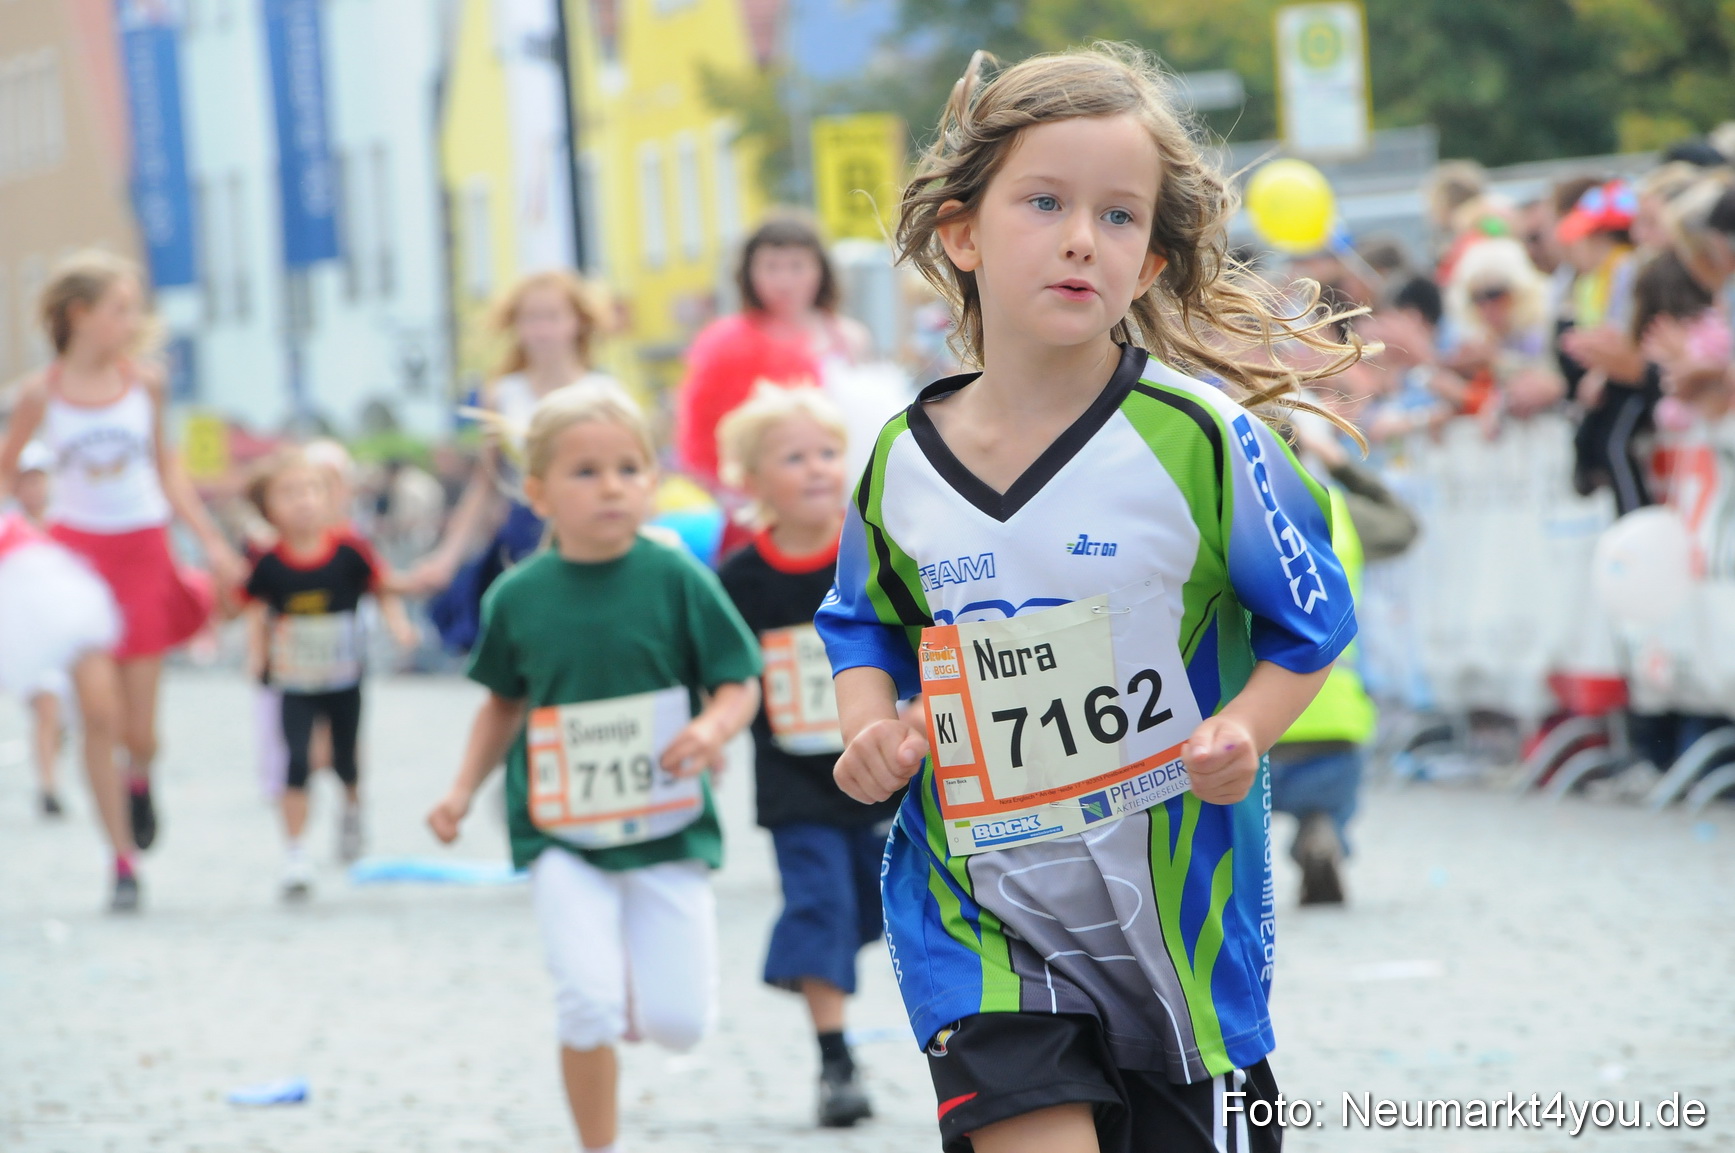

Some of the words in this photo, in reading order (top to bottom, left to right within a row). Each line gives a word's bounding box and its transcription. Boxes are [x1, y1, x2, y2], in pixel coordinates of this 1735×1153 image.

[1231, 411, 1330, 616] BOCK
[918, 552, 996, 592] TEAM
[972, 637, 1057, 681] Nora
[935, 712, 959, 745] K1
[991, 668, 1174, 769] 7162
[972, 814, 1041, 840] BOCK
